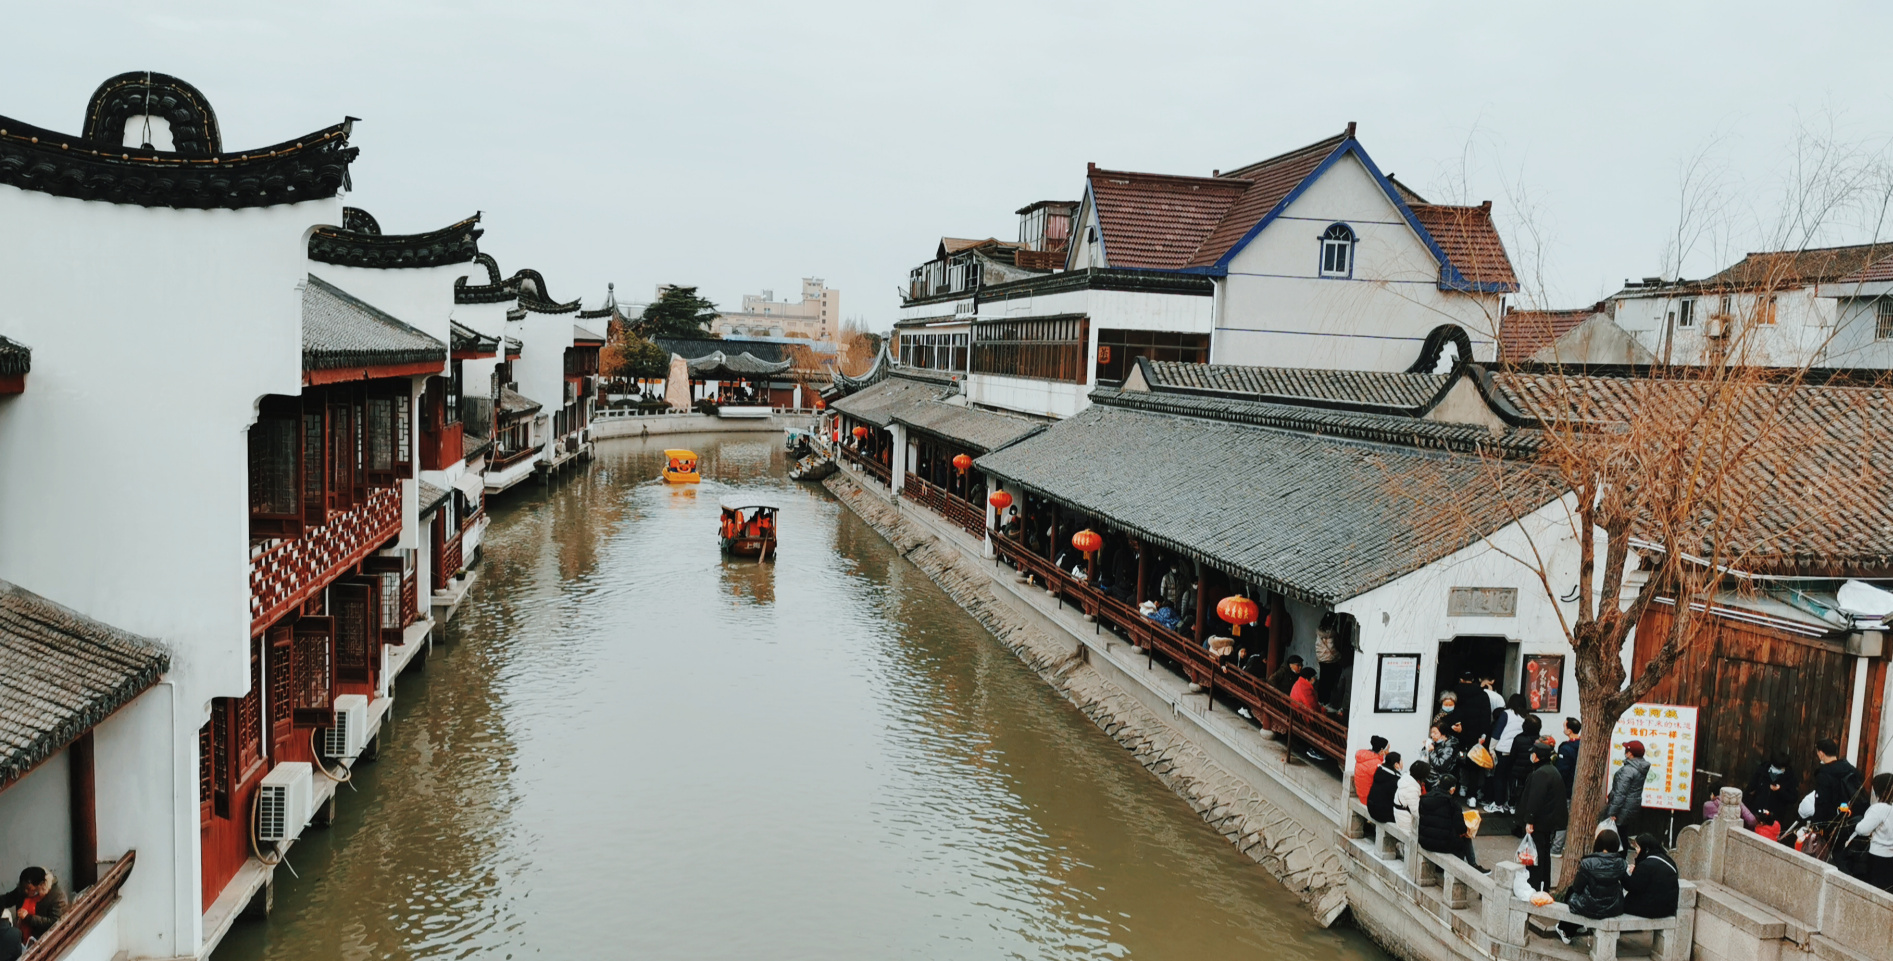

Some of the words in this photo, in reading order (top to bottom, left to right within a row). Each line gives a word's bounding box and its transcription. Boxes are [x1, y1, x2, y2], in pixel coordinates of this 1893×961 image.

[1630, 727, 1678, 739] 我们不一样
